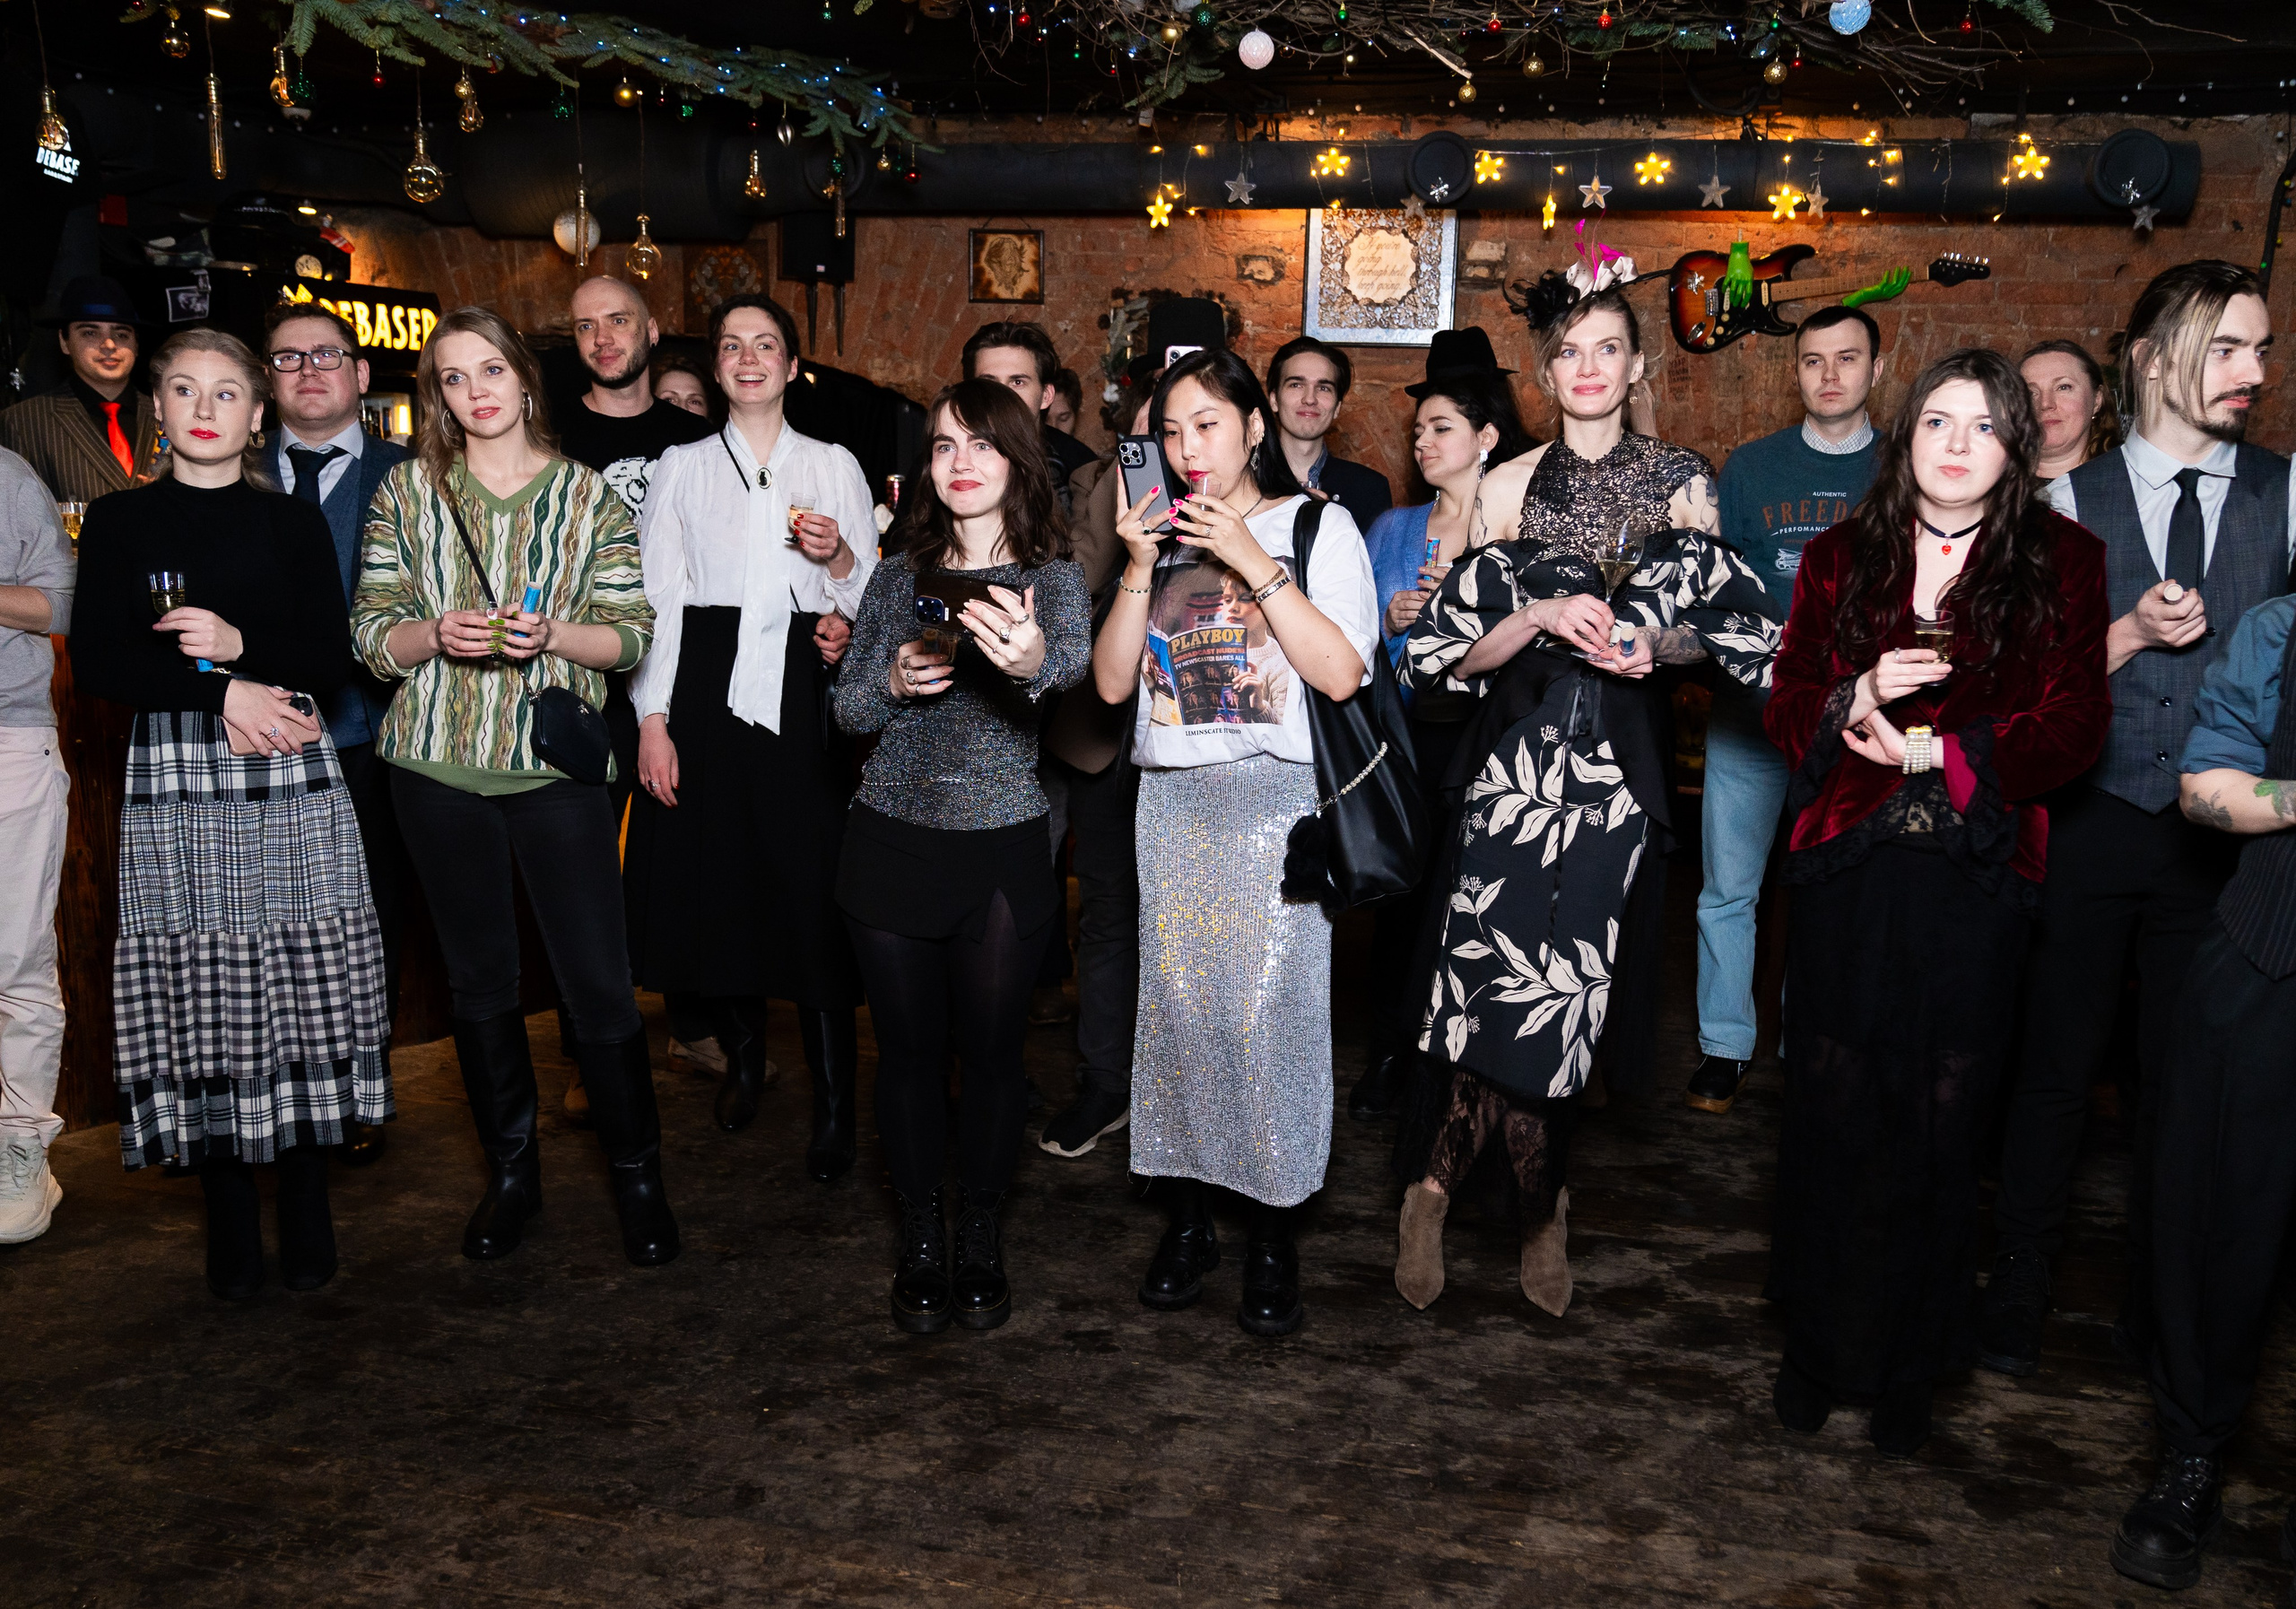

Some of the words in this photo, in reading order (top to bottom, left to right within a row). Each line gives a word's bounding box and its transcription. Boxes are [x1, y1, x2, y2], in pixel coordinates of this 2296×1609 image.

[1352, 256, 1382, 271] going
[1356, 265, 1389, 282] through
[1356, 277, 1375, 295] keep
[1761, 499, 1848, 529] FREED
[1170, 629, 1246, 654] PLAYBOY
[1173, 648, 1216, 664] BROADCAST
[1182, 656, 1215, 667] NEWSCASTER
[1185, 727, 1223, 736] LEMINSCATE
